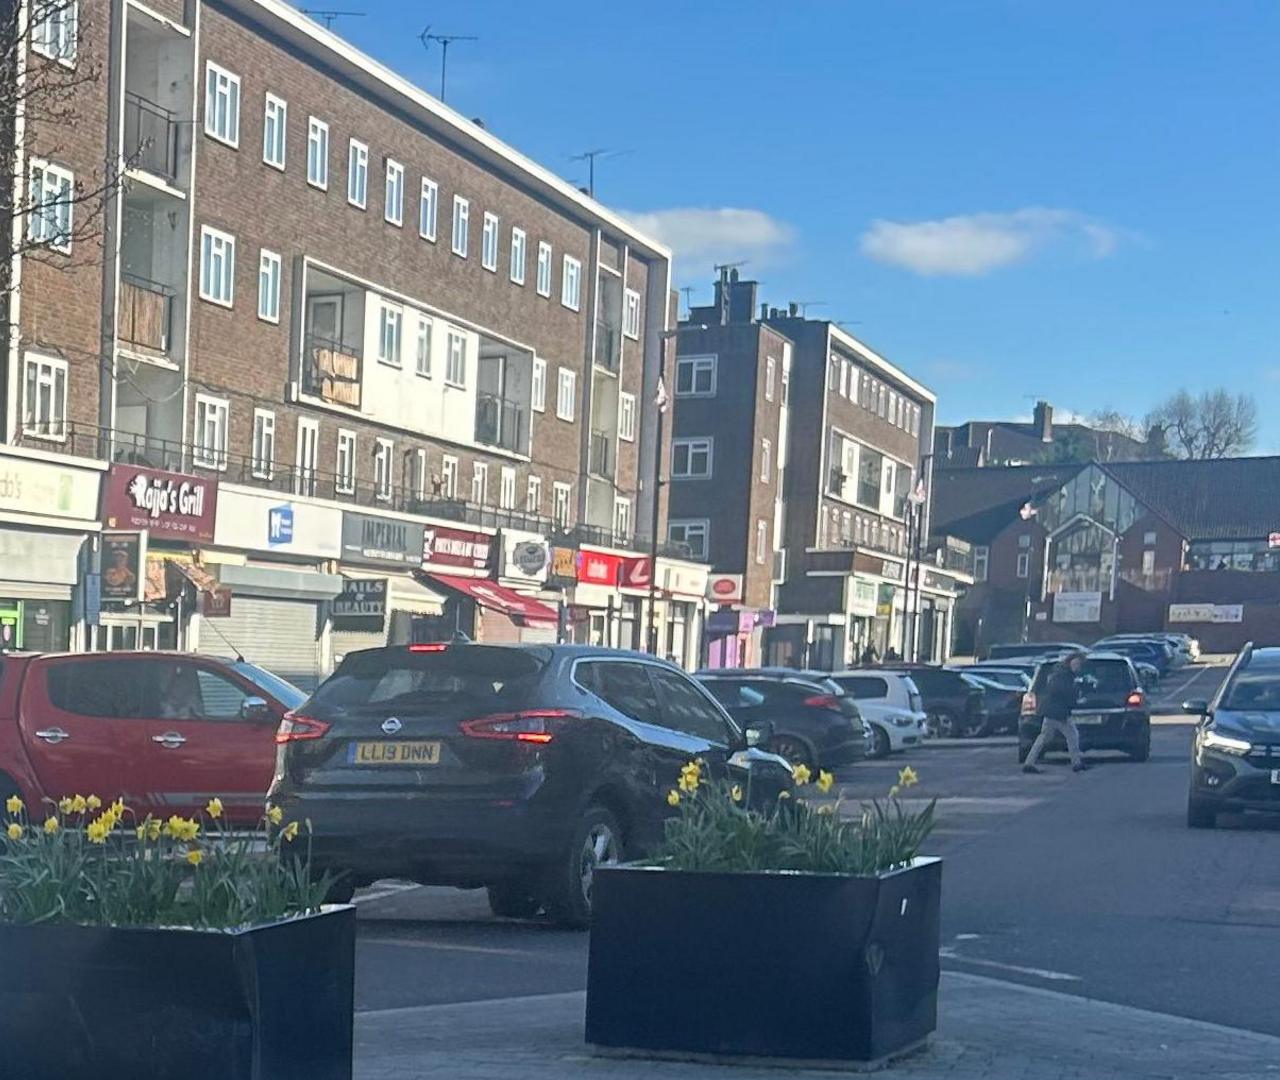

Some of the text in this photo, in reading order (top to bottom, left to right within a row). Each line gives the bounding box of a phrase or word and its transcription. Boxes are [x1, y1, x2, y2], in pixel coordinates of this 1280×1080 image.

[178, 481, 204, 517] Grill
[343, 581, 383, 593] AILS
[334, 601, 384, 613] BEAUTY
